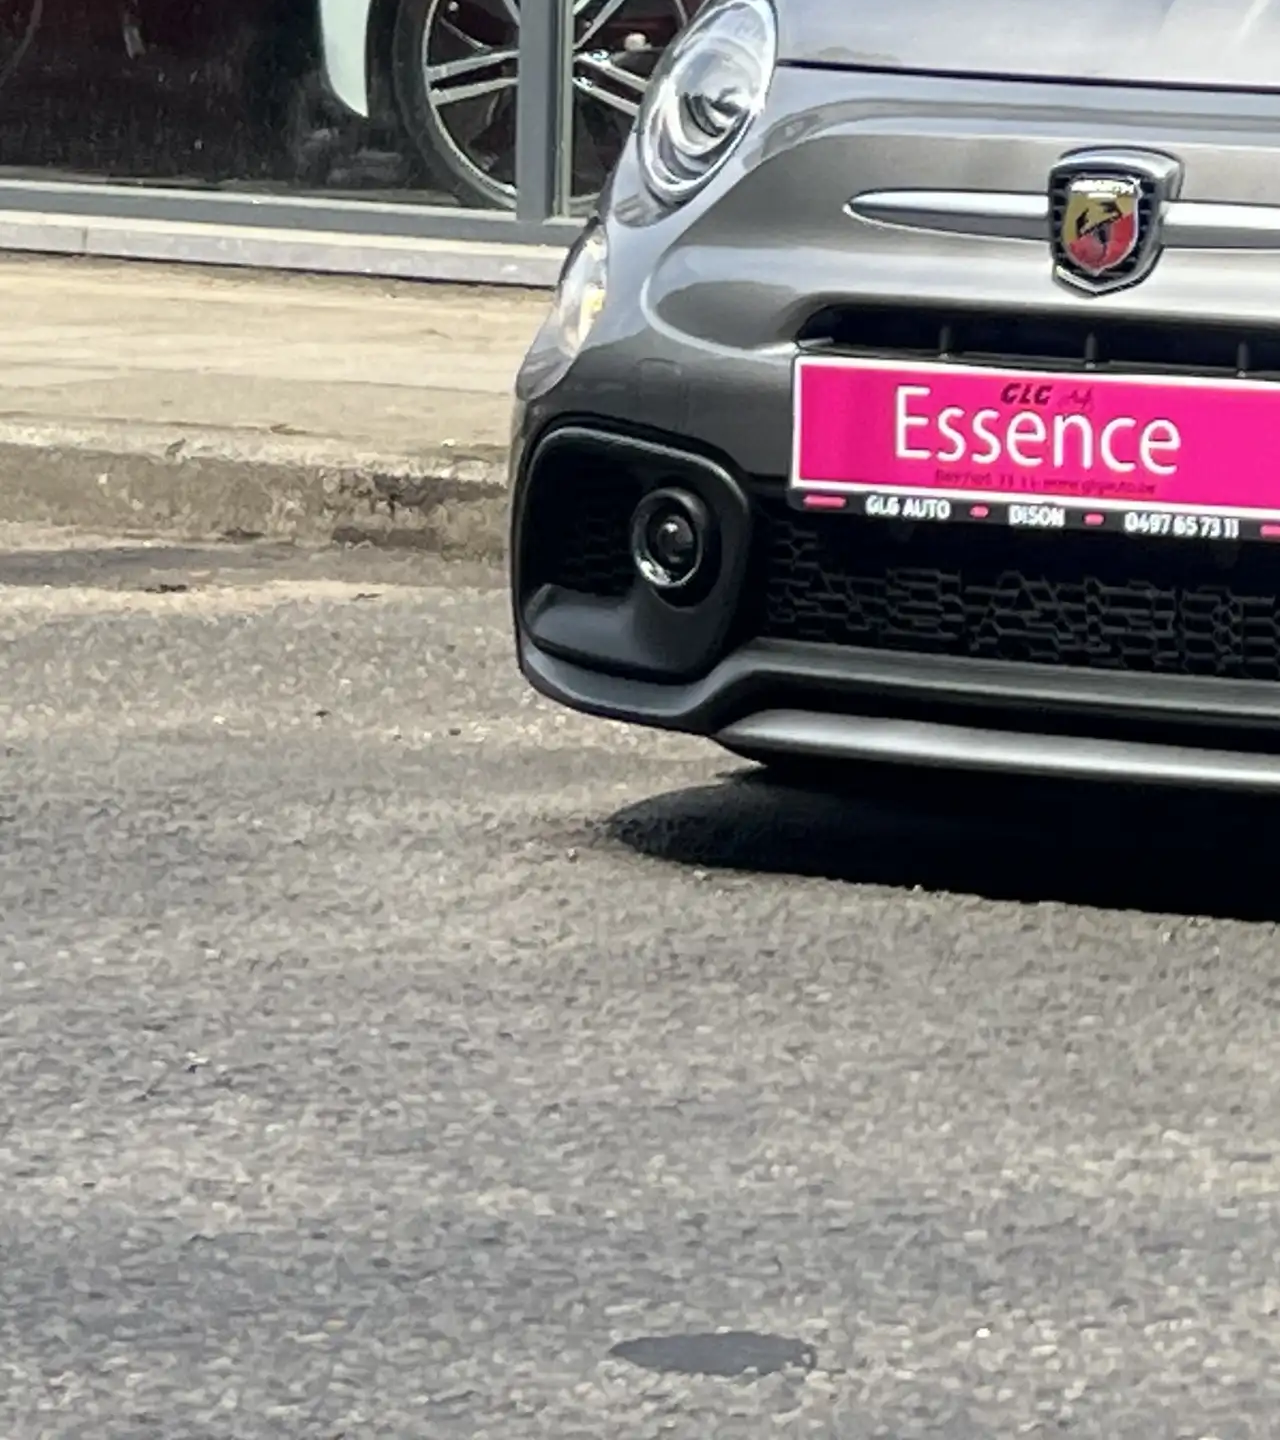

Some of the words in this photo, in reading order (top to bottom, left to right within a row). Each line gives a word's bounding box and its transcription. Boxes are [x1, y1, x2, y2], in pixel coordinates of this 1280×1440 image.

[895, 384, 1181, 475] Essence
[866, 496, 899, 517] GLG
[902, 498, 951, 520] AUTO
[1008, 505, 1065, 527] DISON
[1124, 512, 1170, 533] 0497
[1172, 515, 1198, 536] 65
[1200, 516, 1221, 537] 73
[1222, 517, 1240, 538] 11
